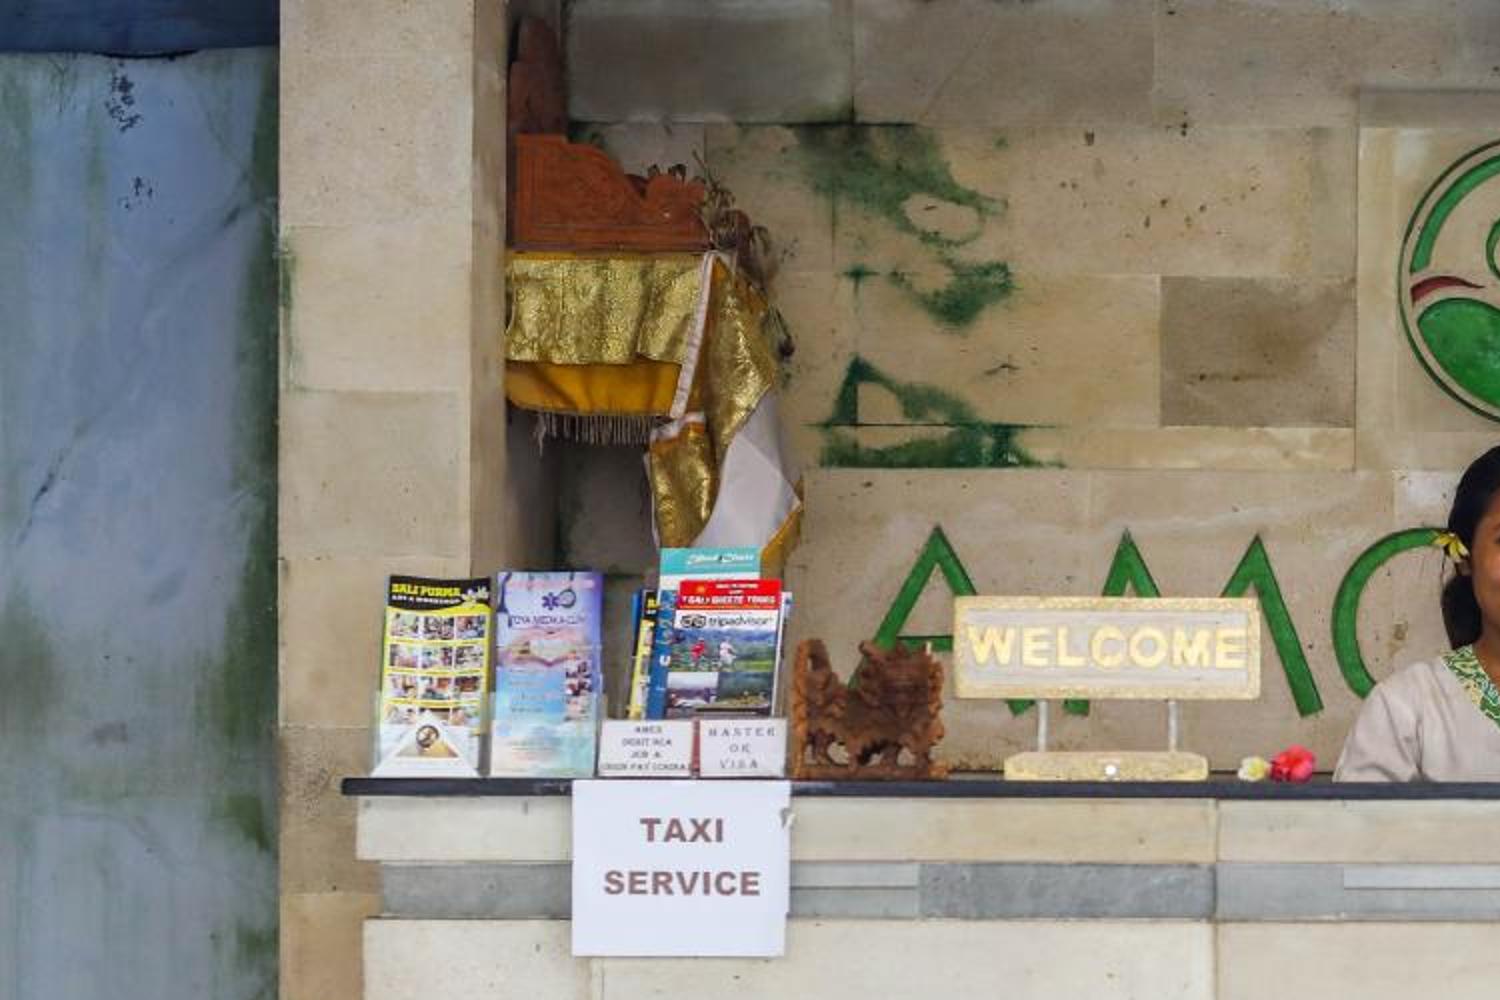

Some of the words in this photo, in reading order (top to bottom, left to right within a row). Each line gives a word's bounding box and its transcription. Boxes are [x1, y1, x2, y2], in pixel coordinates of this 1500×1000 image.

[391, 584, 418, 595] BALI
[708, 615, 771, 626] tripadvisor
[966, 626, 1248, 669] WELCOME
[719, 758, 758, 769] VISA
[640, 818, 724, 843] TAXI
[603, 870, 761, 896] SERVICE
